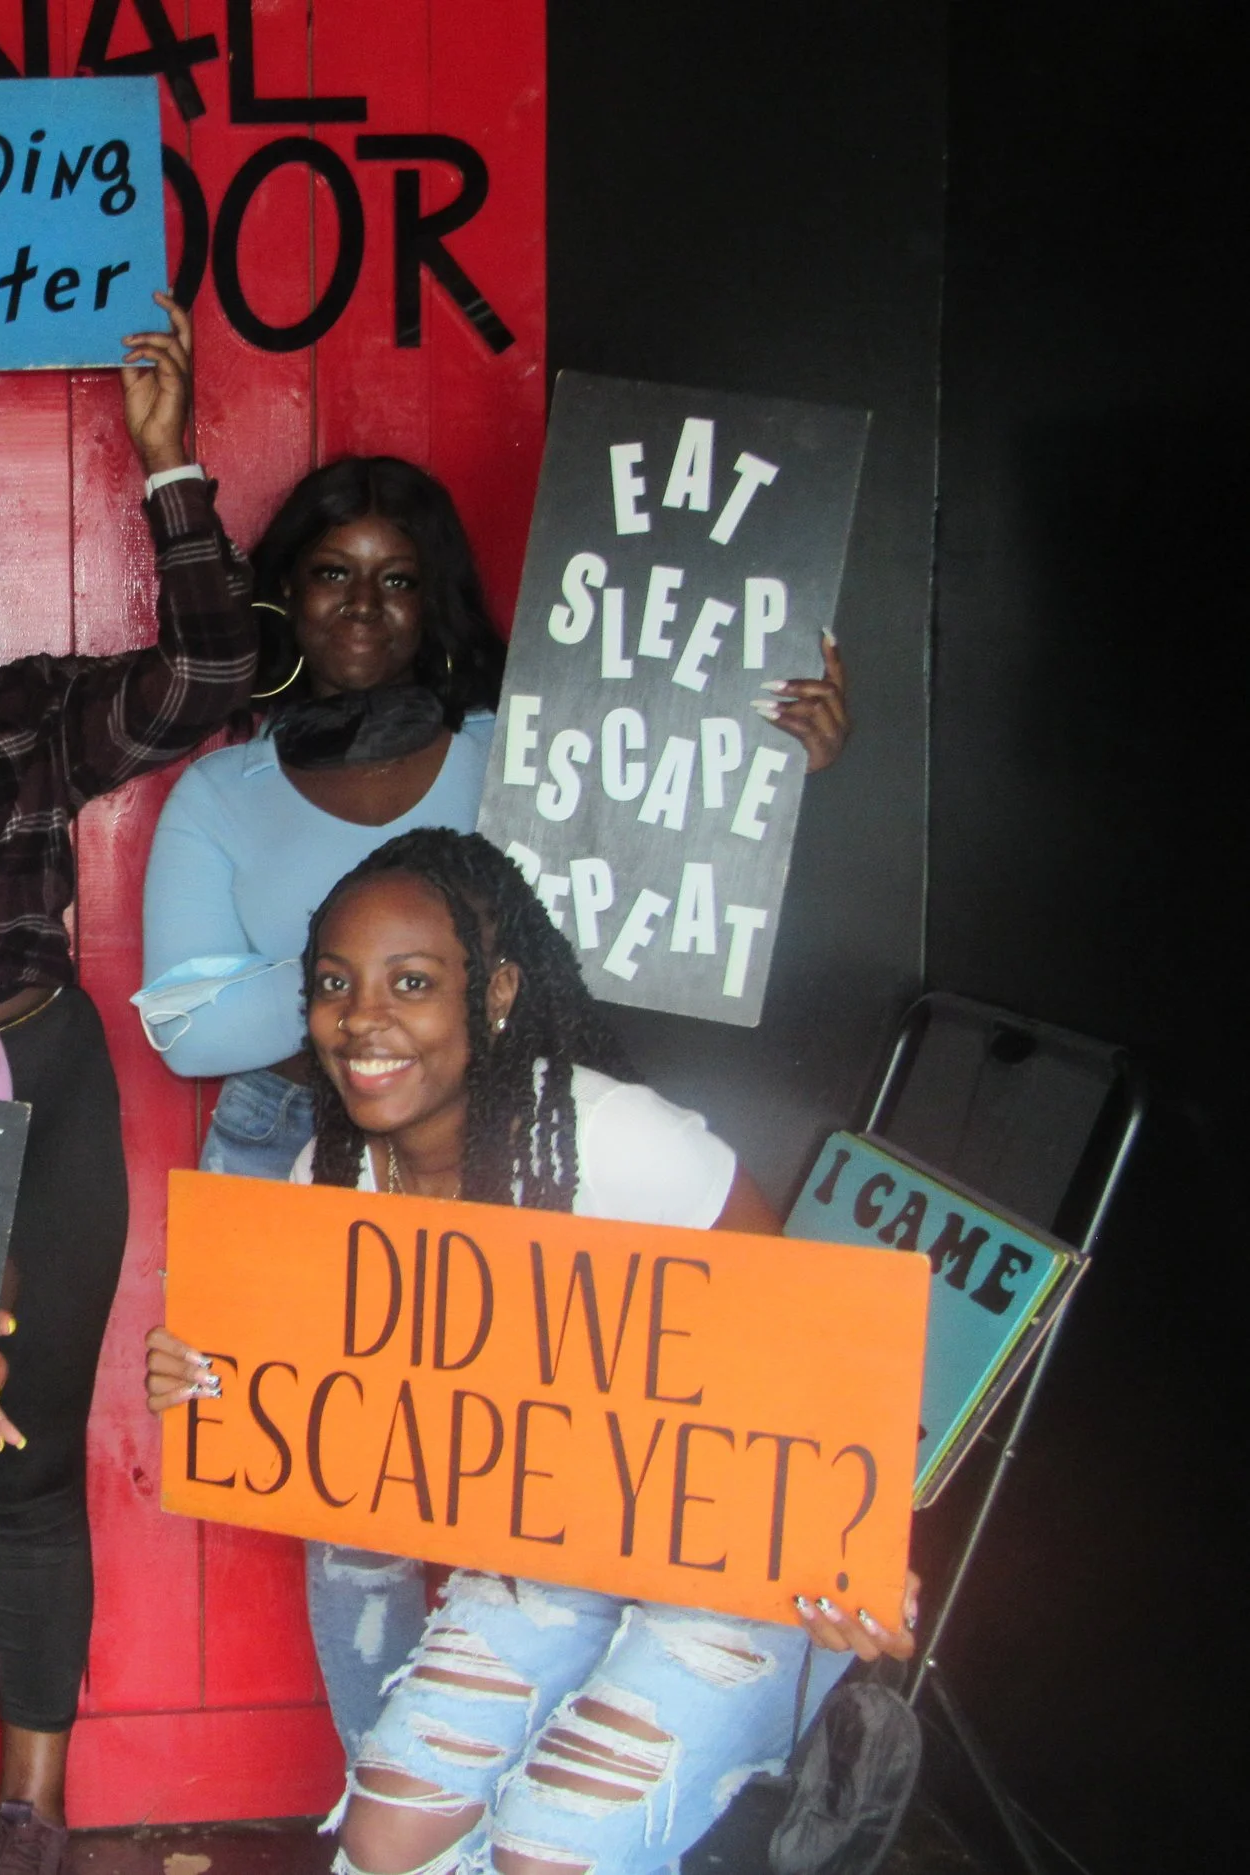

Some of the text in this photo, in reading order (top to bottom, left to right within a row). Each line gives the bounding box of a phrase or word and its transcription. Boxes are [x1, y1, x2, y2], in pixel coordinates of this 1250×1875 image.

[162, 135, 516, 355] OR
[609, 418, 779, 545] EAT
[549, 552, 786, 692] SLEEP
[503, 695, 788, 841] ESCAPE
[343, 1219, 711, 1406] DID WE
[814, 1149, 1033, 1316] I CAME
[186, 1352, 878, 1594] ESCAPE YET?
